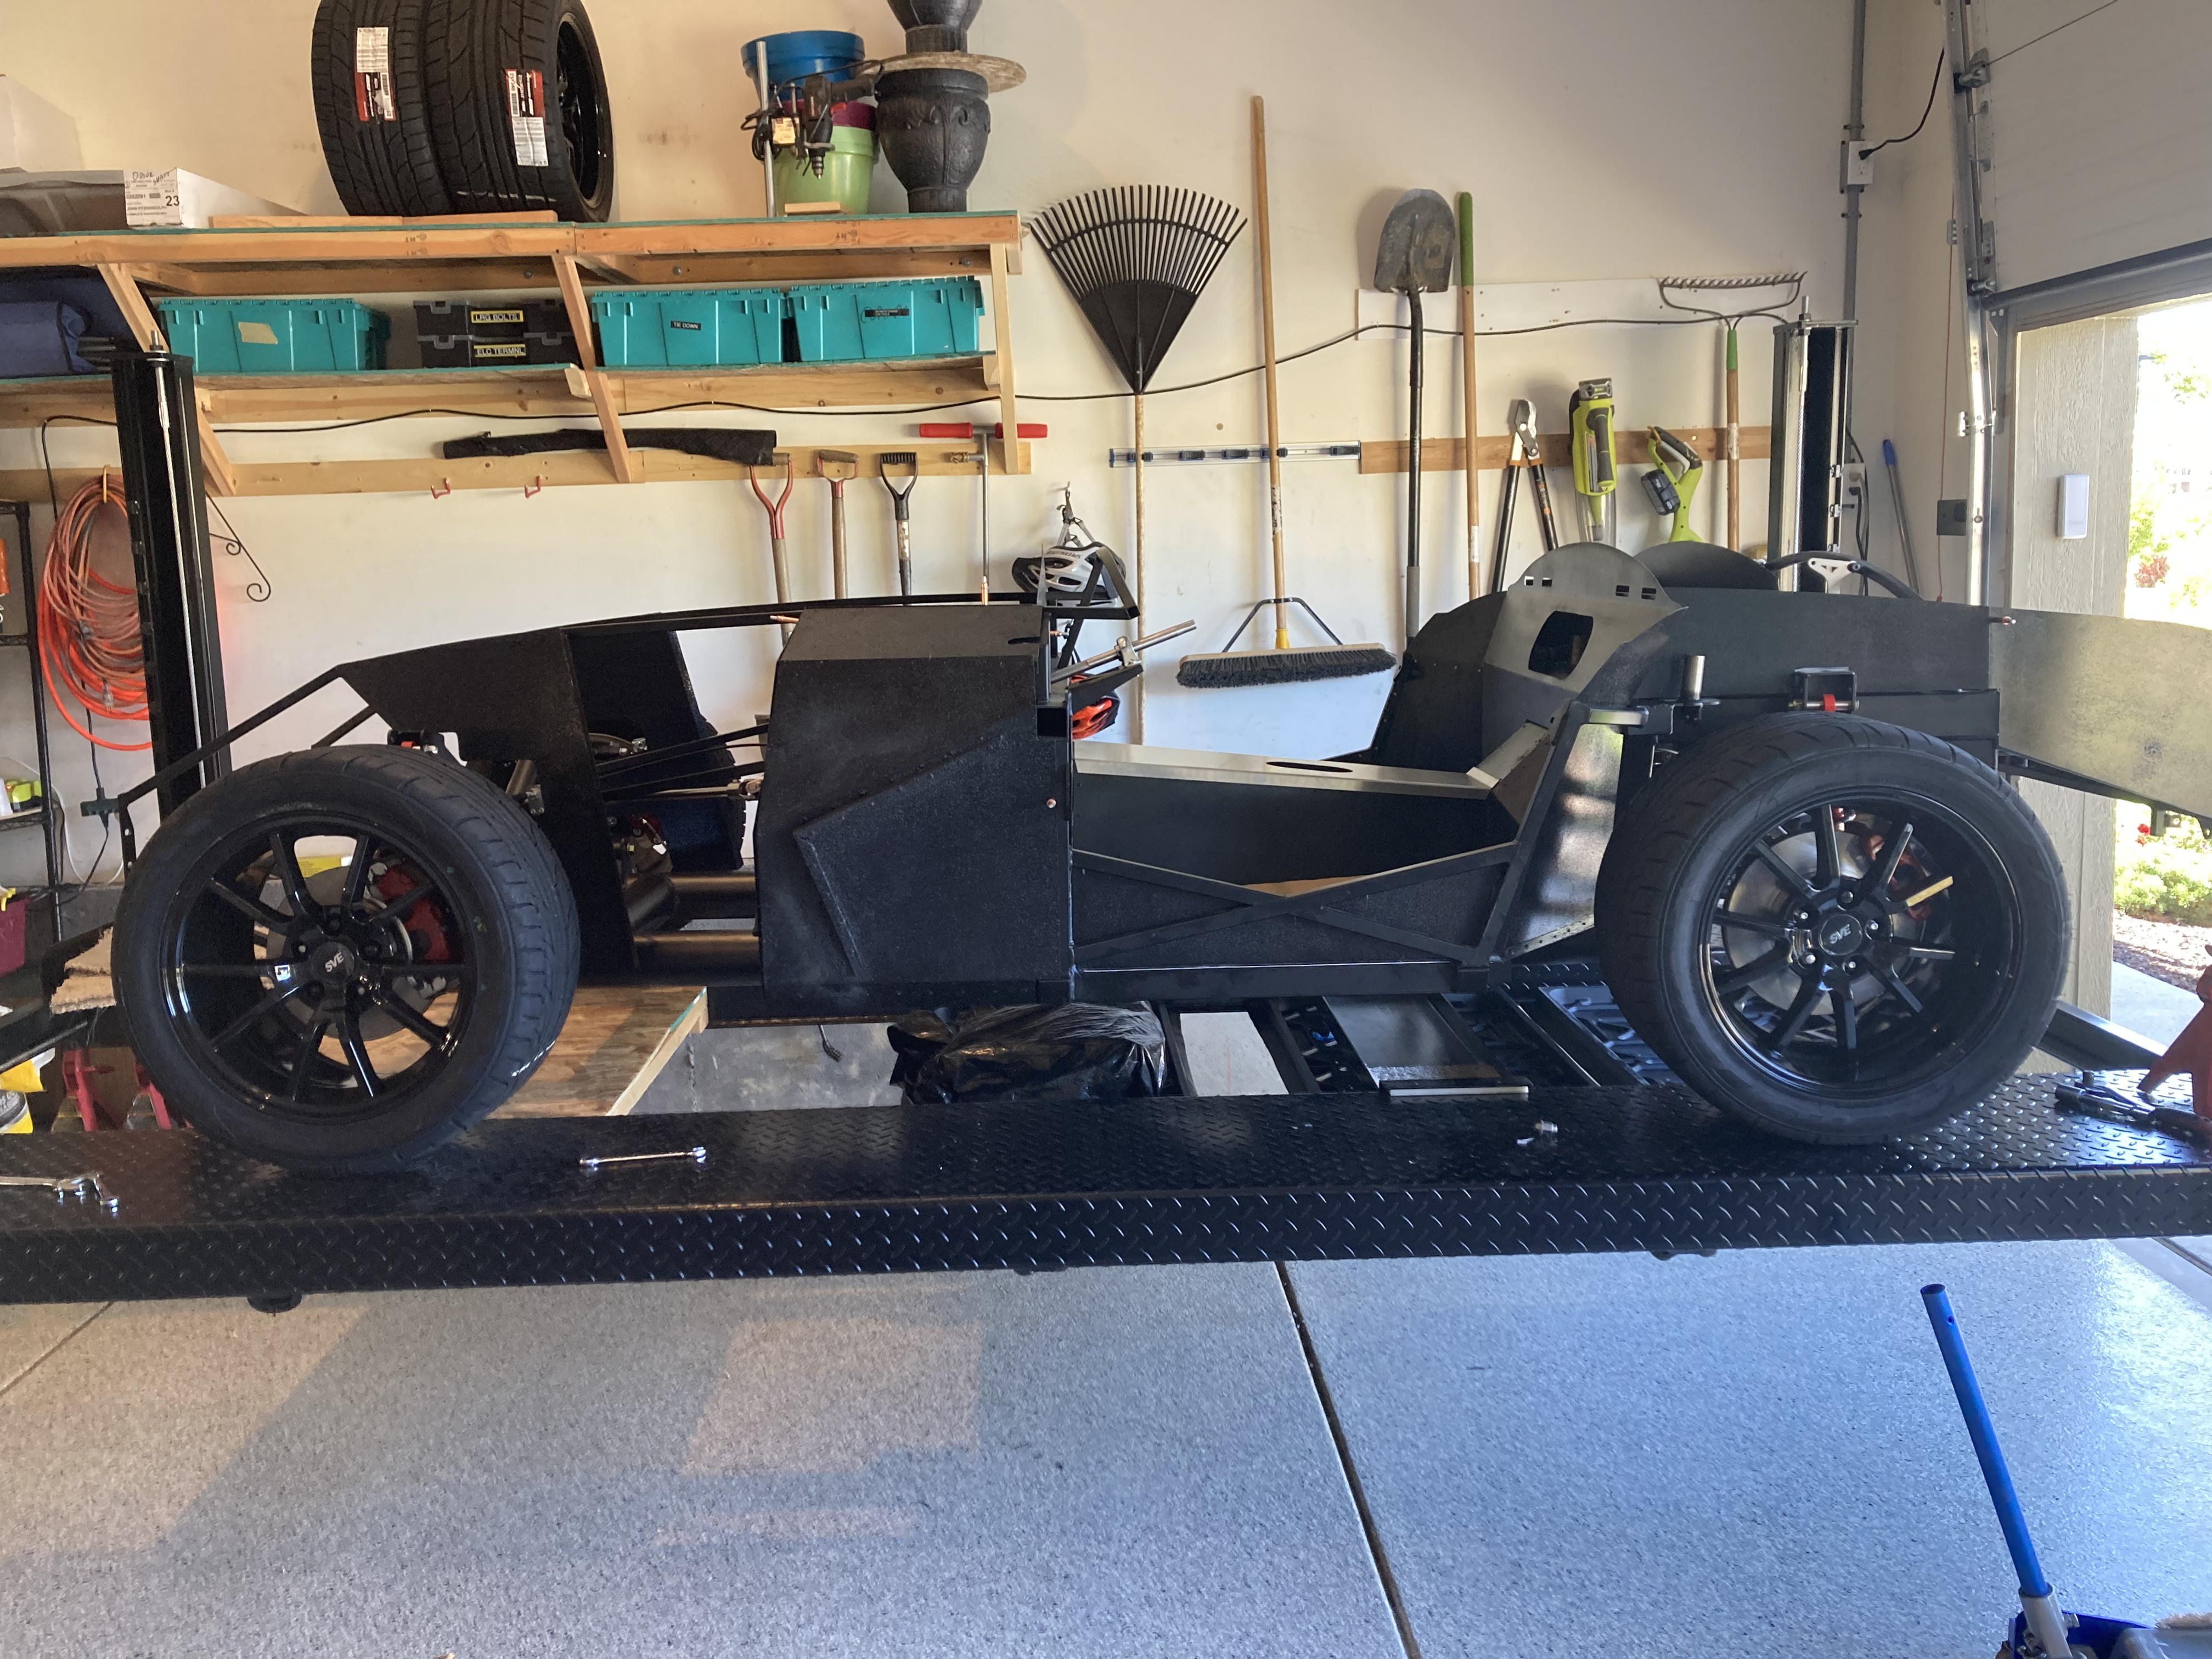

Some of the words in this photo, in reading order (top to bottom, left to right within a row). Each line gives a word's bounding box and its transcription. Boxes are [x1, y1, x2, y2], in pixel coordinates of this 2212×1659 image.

[165, 195, 179, 206] 23
[1830, 924, 1851, 944] SVE
[325, 952, 344, 972] SVE
